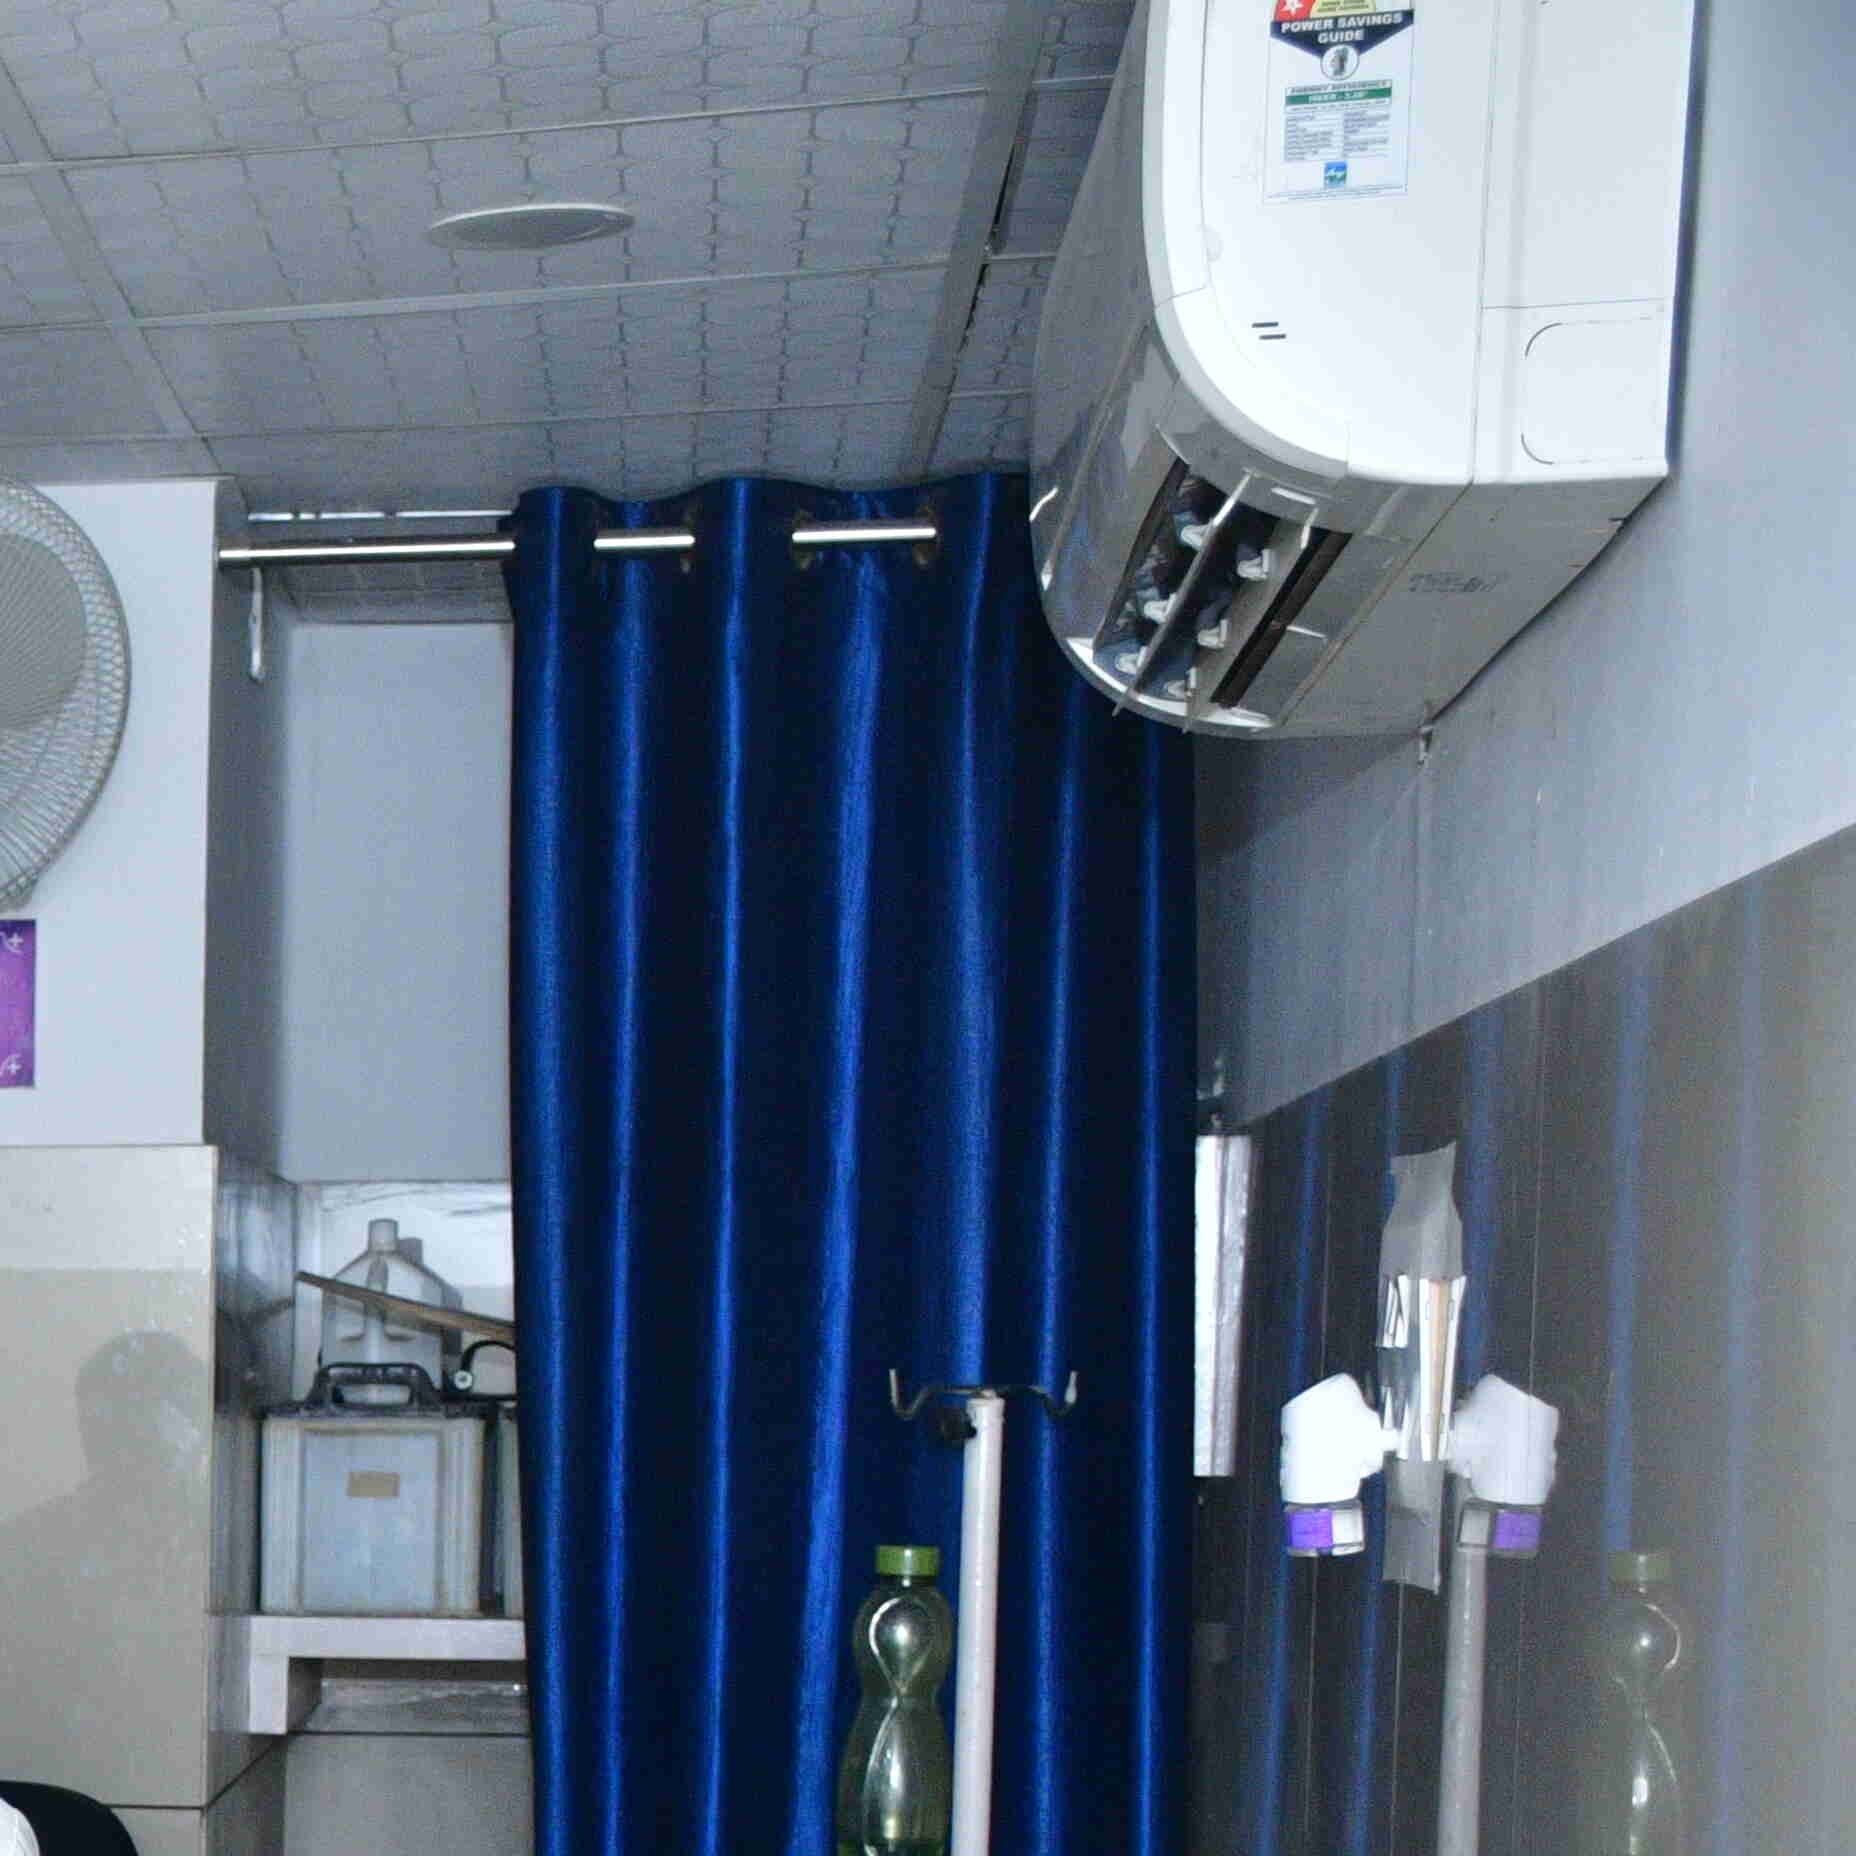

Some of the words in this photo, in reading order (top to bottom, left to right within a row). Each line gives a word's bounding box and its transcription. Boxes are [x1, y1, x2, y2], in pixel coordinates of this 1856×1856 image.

[1281, 19, 1333, 33] POWER
[1338, 12, 1403, 29] SAVINGS
[1318, 29, 1365, 44] GUIDE
